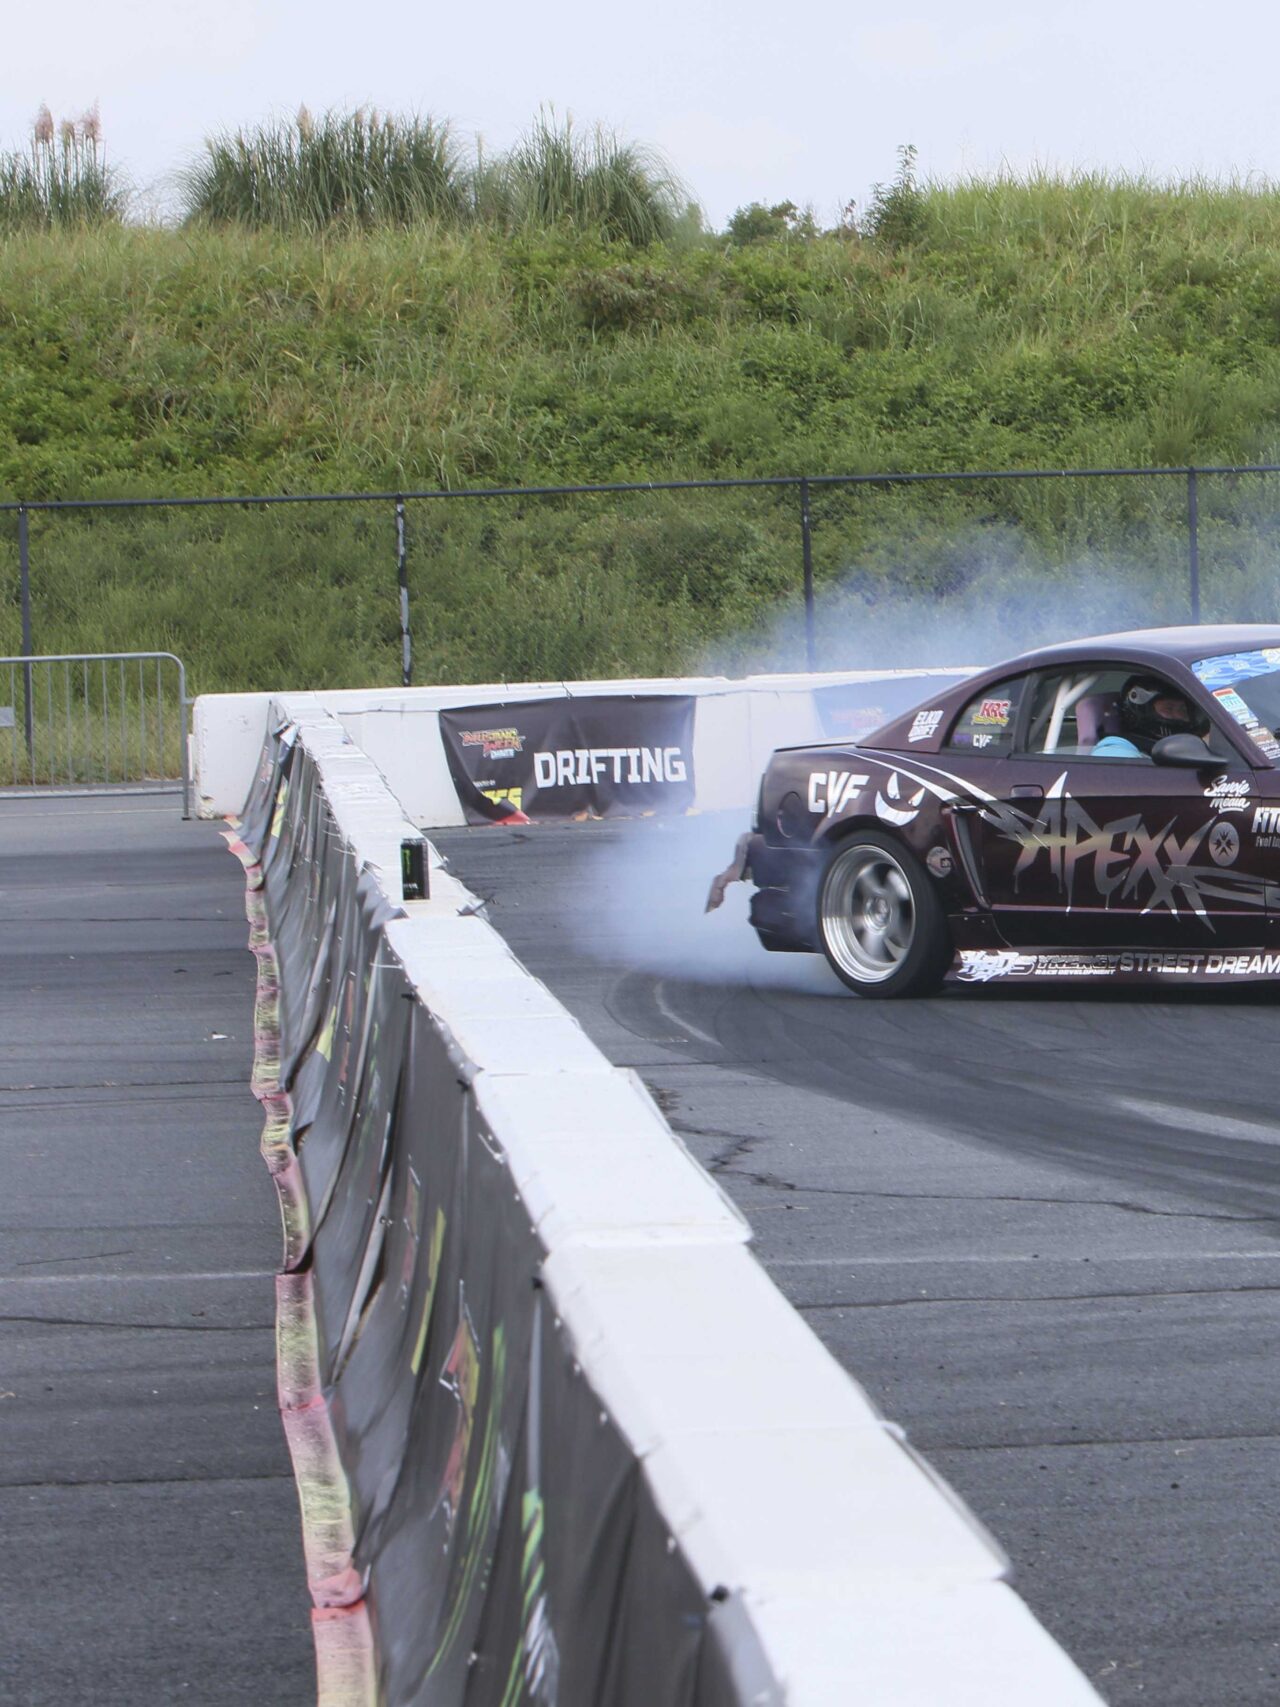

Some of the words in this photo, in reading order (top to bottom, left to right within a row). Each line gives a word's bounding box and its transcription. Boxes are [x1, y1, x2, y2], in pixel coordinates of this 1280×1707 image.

[972, 734, 993, 749] CVF
[533, 747, 688, 789] DRIFTING
[808, 770, 871, 819] CVF
[1120, 951, 1208, 973] STREET
